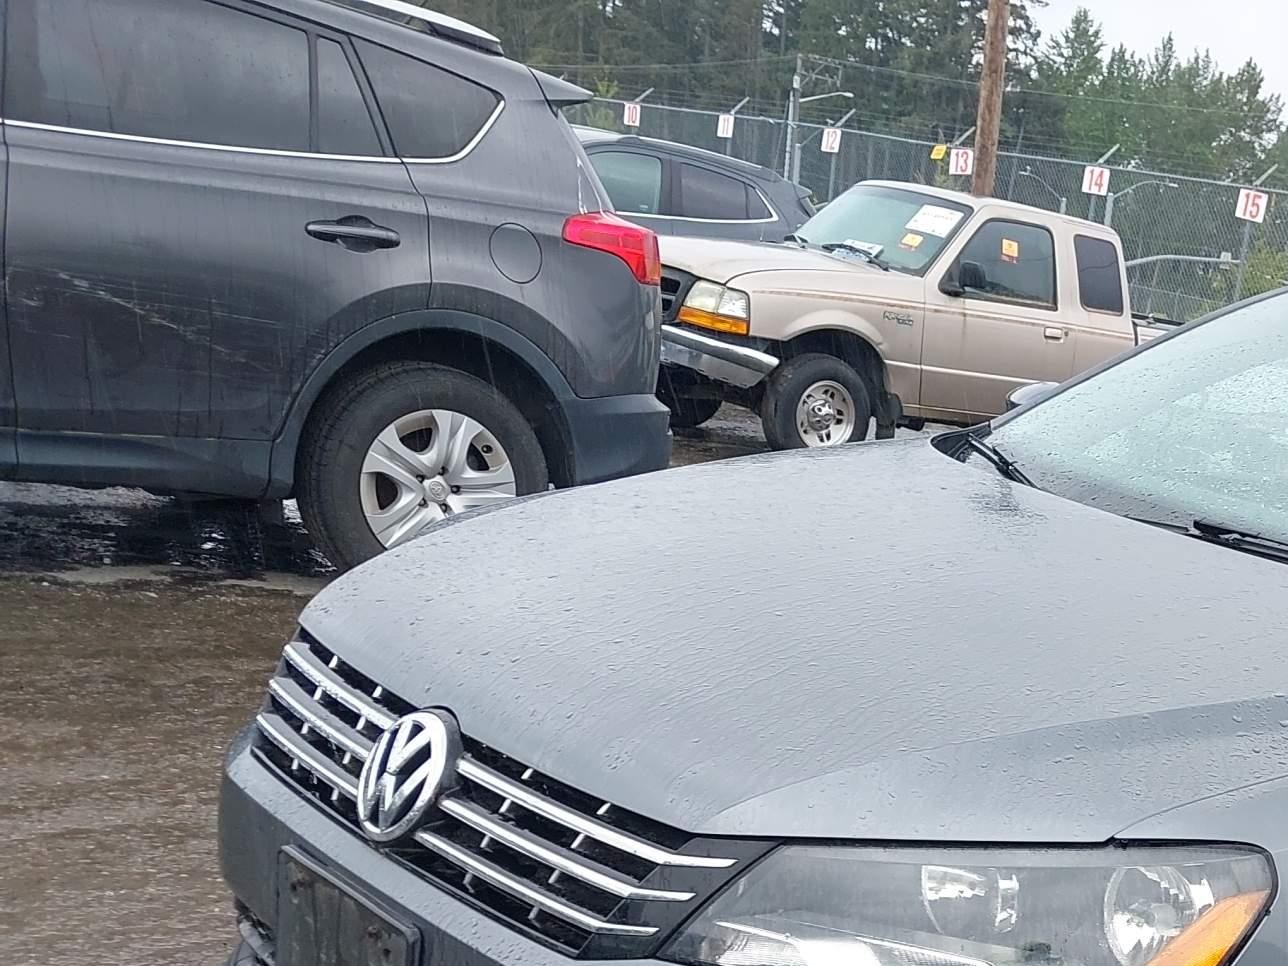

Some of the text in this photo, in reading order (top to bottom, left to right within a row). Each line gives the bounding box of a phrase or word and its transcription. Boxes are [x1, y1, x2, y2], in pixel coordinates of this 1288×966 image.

[627, 106, 638, 124] 10
[722, 117, 730, 135] 11
[825, 130, 838, 150] 12
[955, 151, 969, 172] 13
[1088, 169, 1104, 193] 14
[1243, 192, 1262, 219] 15
